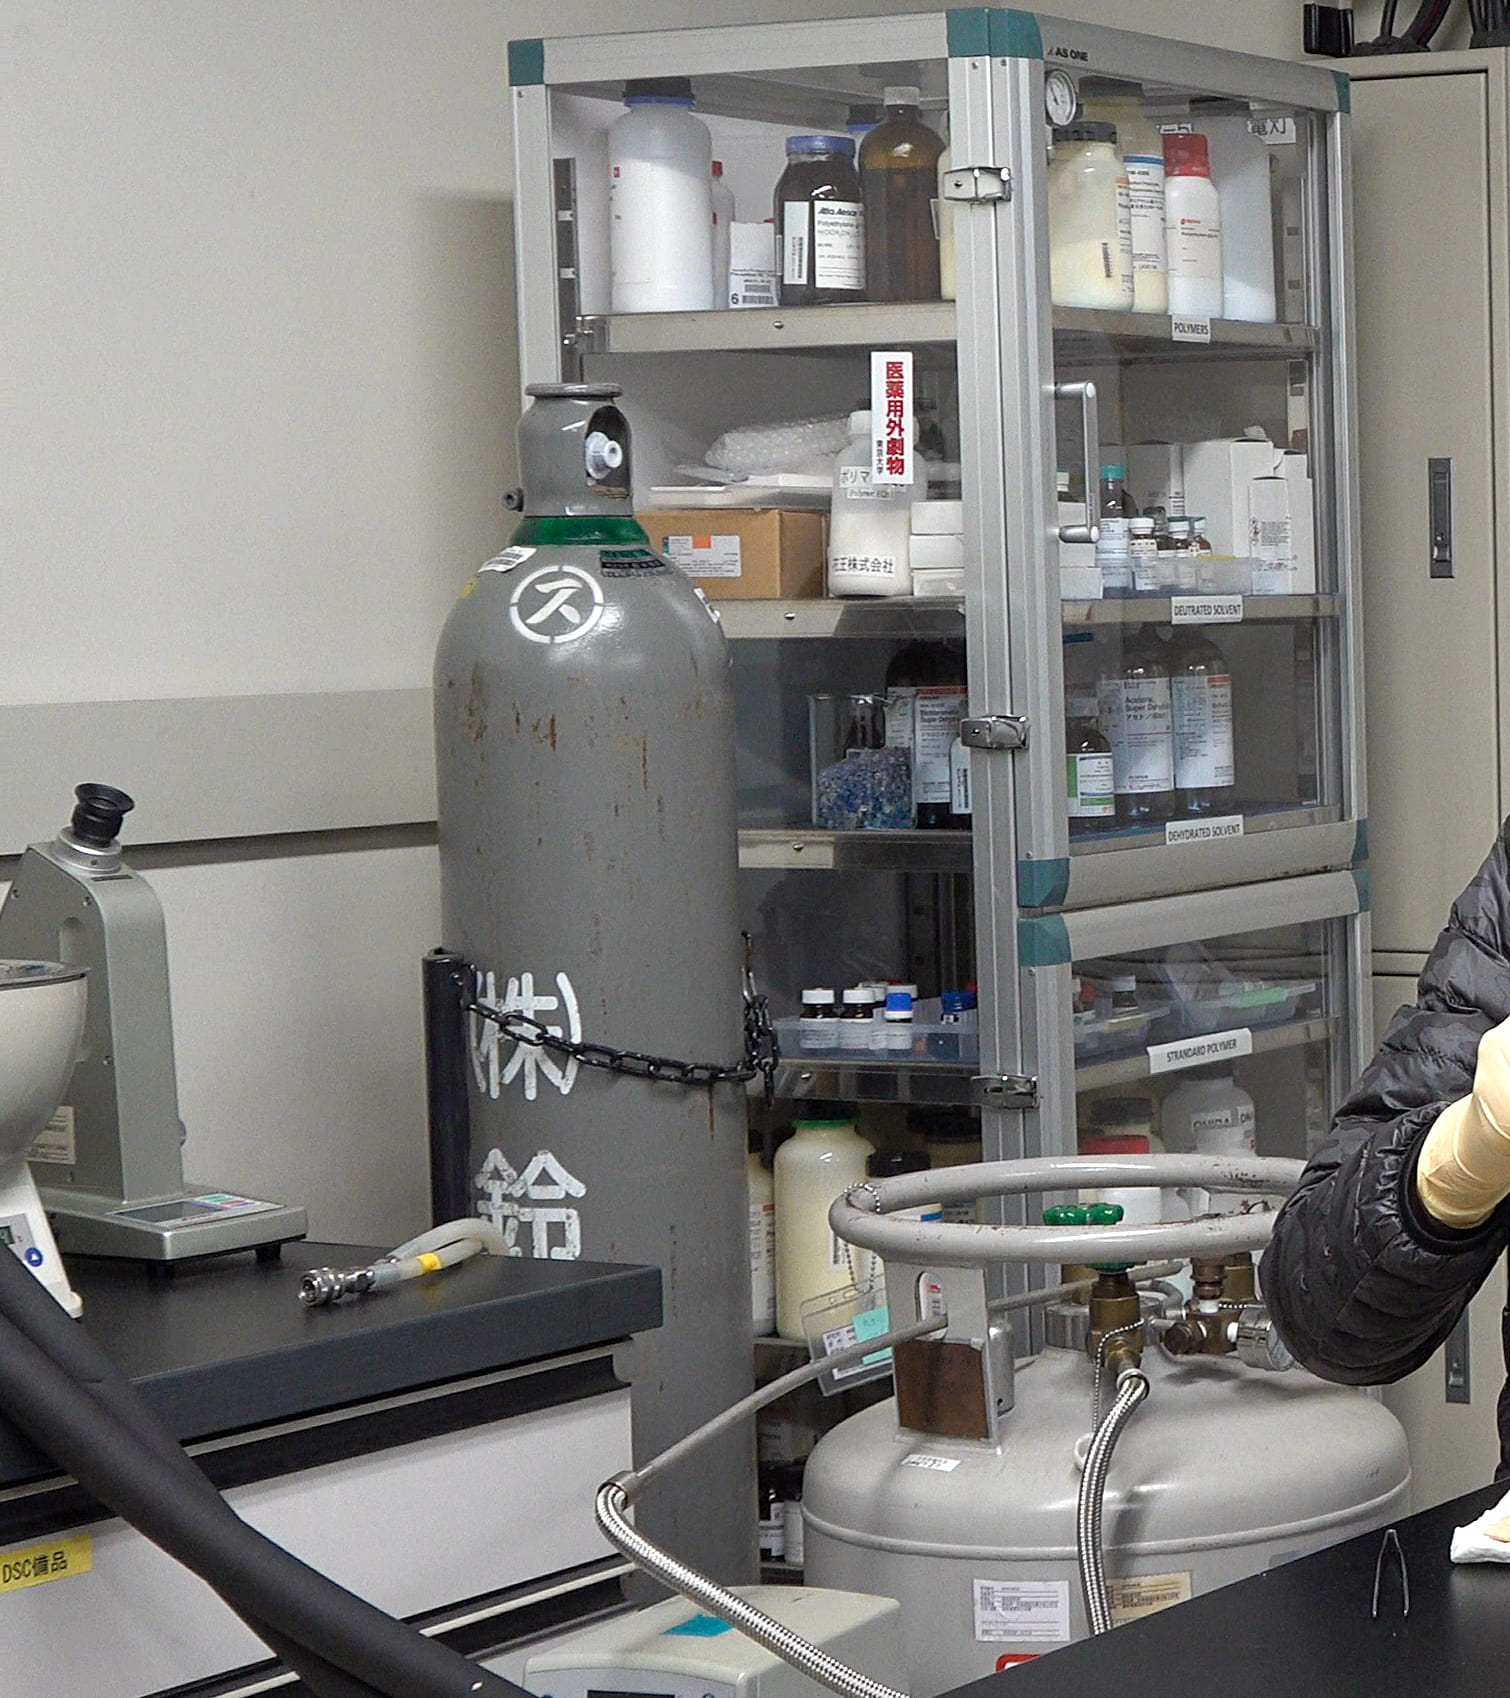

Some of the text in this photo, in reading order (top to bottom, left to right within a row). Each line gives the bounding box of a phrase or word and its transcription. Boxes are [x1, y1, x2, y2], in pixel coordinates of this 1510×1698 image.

[731, 293, 740, 305] 6
[1174, 322, 1209, 335] POLYMERS
[885, 361, 905, 476] 医薬用外劇物
[1213, 604, 1241, 616] SOLVENT
[1168, 823, 1240, 842] DEHYDRATED SOLVENT
[1207, 1038, 1237, 1054] POLYMER
[3, 1550, 68, 1583] DSC備品
